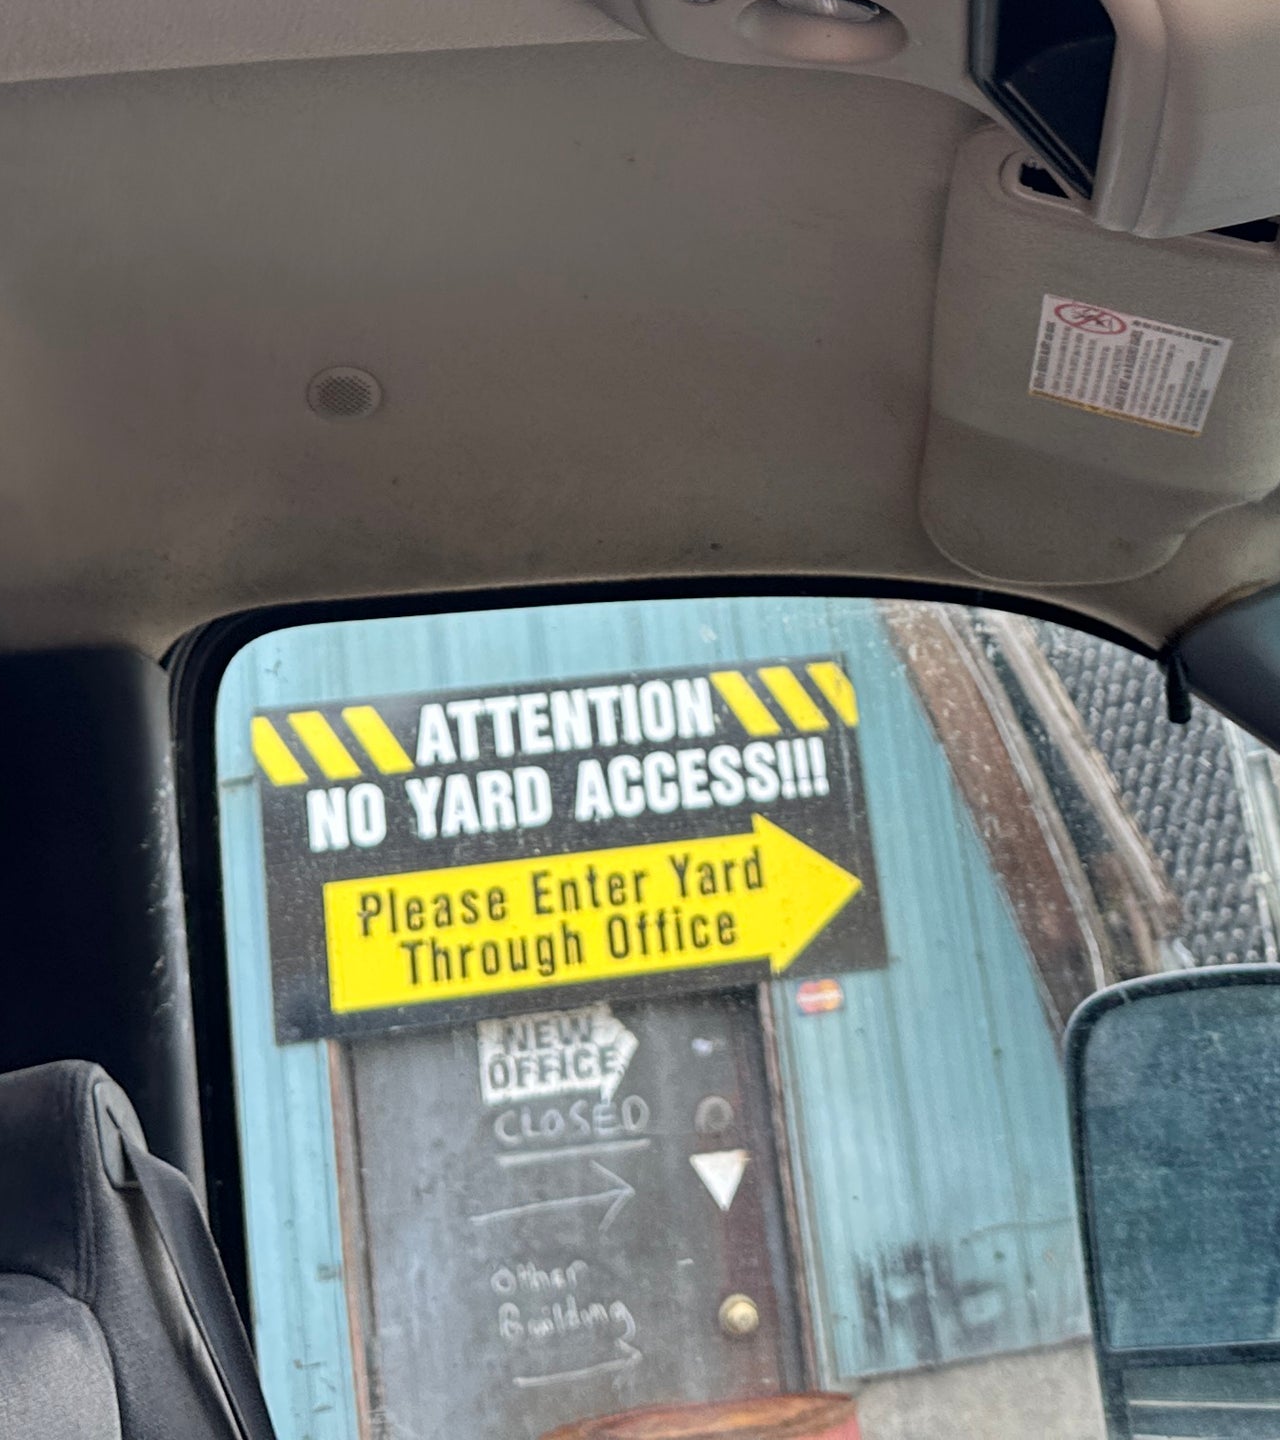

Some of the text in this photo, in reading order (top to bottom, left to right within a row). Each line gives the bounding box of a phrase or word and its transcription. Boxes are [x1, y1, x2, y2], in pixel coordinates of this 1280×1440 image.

[415, 676, 715, 767] ATTENTION
[306, 737, 830, 852] NO YARD ACCESS!!!
[358, 846, 766, 937] Please Enter Yard
[401, 909, 737, 986] Through Office
[502, 1016, 593, 1052] NEW
[489, 1046, 619, 1090] OFFICE
[493, 1095, 651, 1145] CLOSED
[490, 1259, 589, 1296] Other
[497, 1294, 637, 1343] Building
